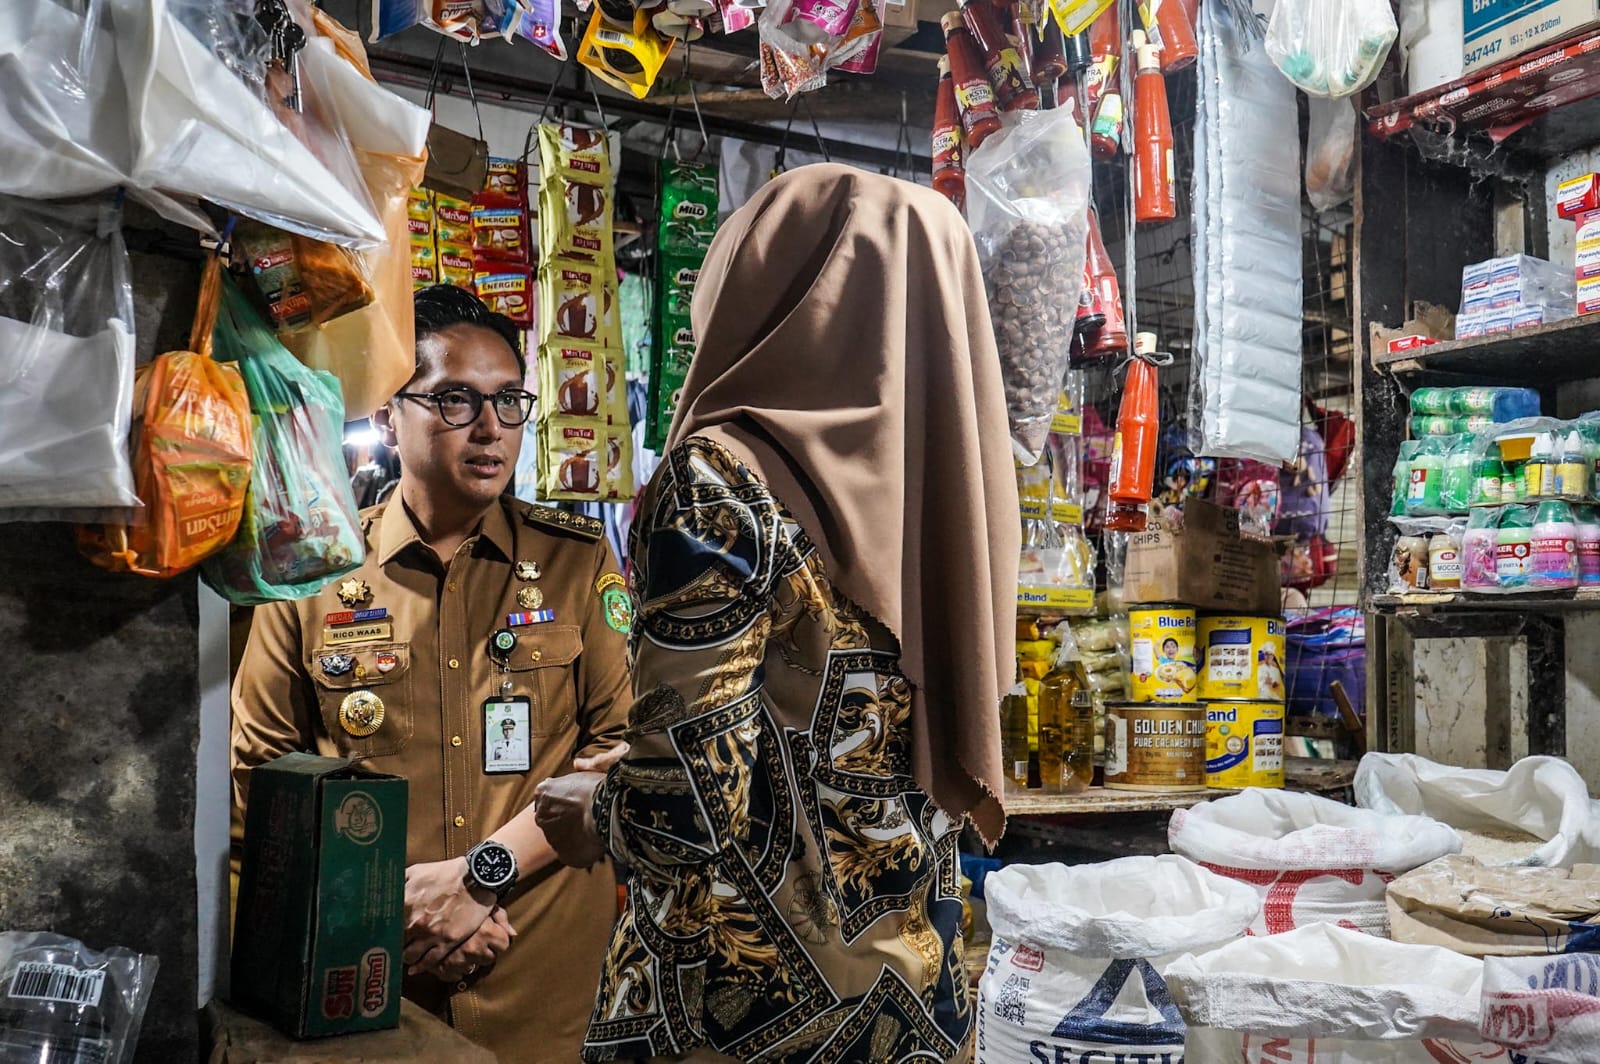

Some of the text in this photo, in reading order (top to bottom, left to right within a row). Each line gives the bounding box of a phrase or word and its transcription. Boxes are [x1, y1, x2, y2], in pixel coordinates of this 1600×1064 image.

[1464, 38, 1503, 66] 347447
[1524, 28, 1533, 38] 12
[1540, 15, 1561, 33] 200ml
[678, 205, 705, 217] MILO
[478, 216, 517, 226] ENERGEN
[482, 280, 523, 291] ENERGEN
[1133, 533, 1161, 545] CHIPS
[1024, 592, 1047, 602] Band
[1158, 616, 1184, 627] Blue
[333, 628, 382, 639] RICO WAAS
[1134, 718, 1183, 735] GOLDEN
[1133, 737, 1153, 748] PURE
[1155, 737, 1192, 748] CREAMERY
